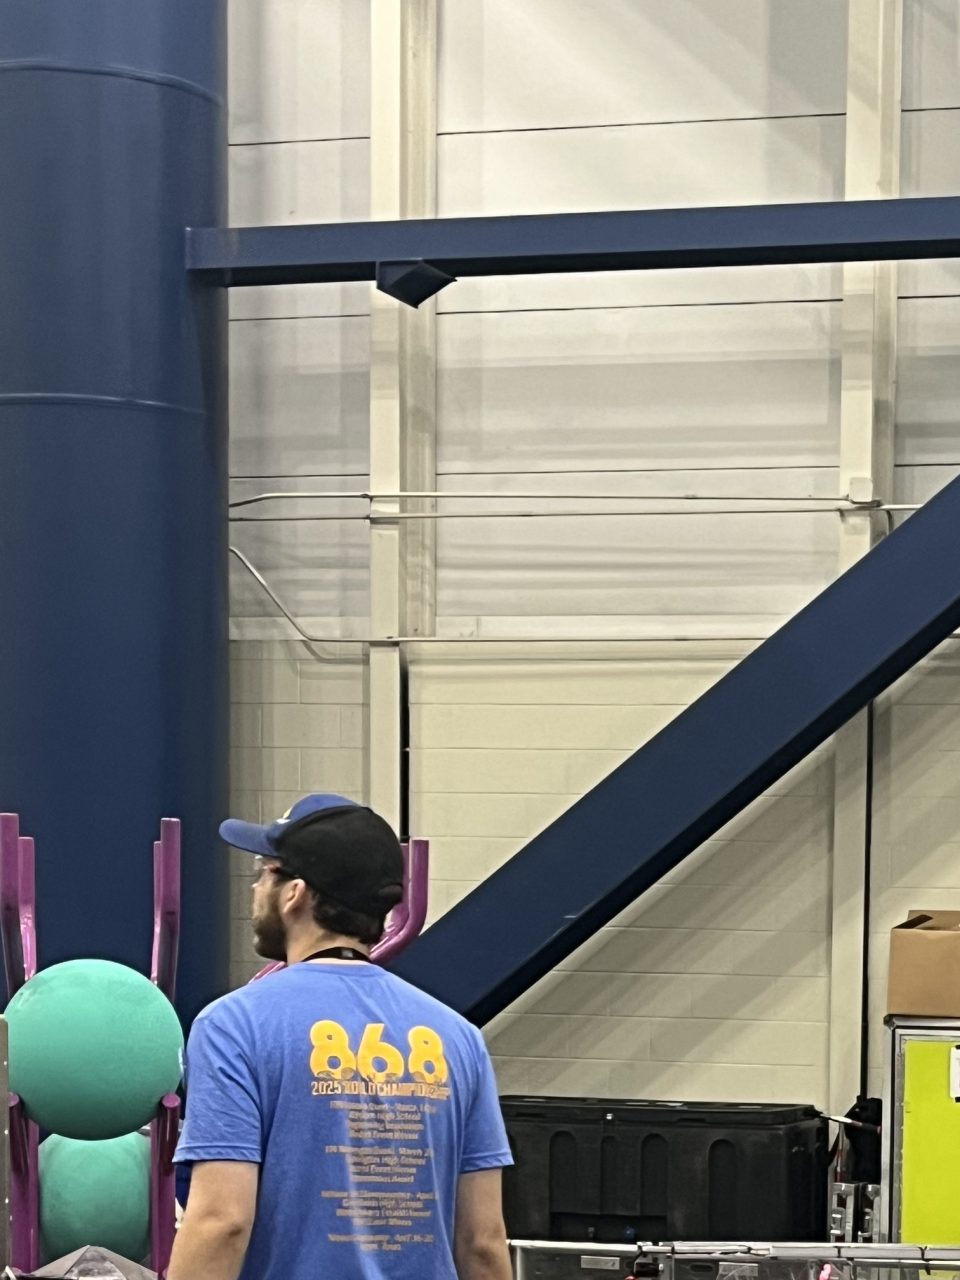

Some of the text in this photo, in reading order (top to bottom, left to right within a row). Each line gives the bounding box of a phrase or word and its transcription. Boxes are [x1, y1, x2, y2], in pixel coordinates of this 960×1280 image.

[310, 1020, 449, 1084] 868
[311, 1081, 341, 1096] 2025
[341, 1081, 376, 1096] OLD
